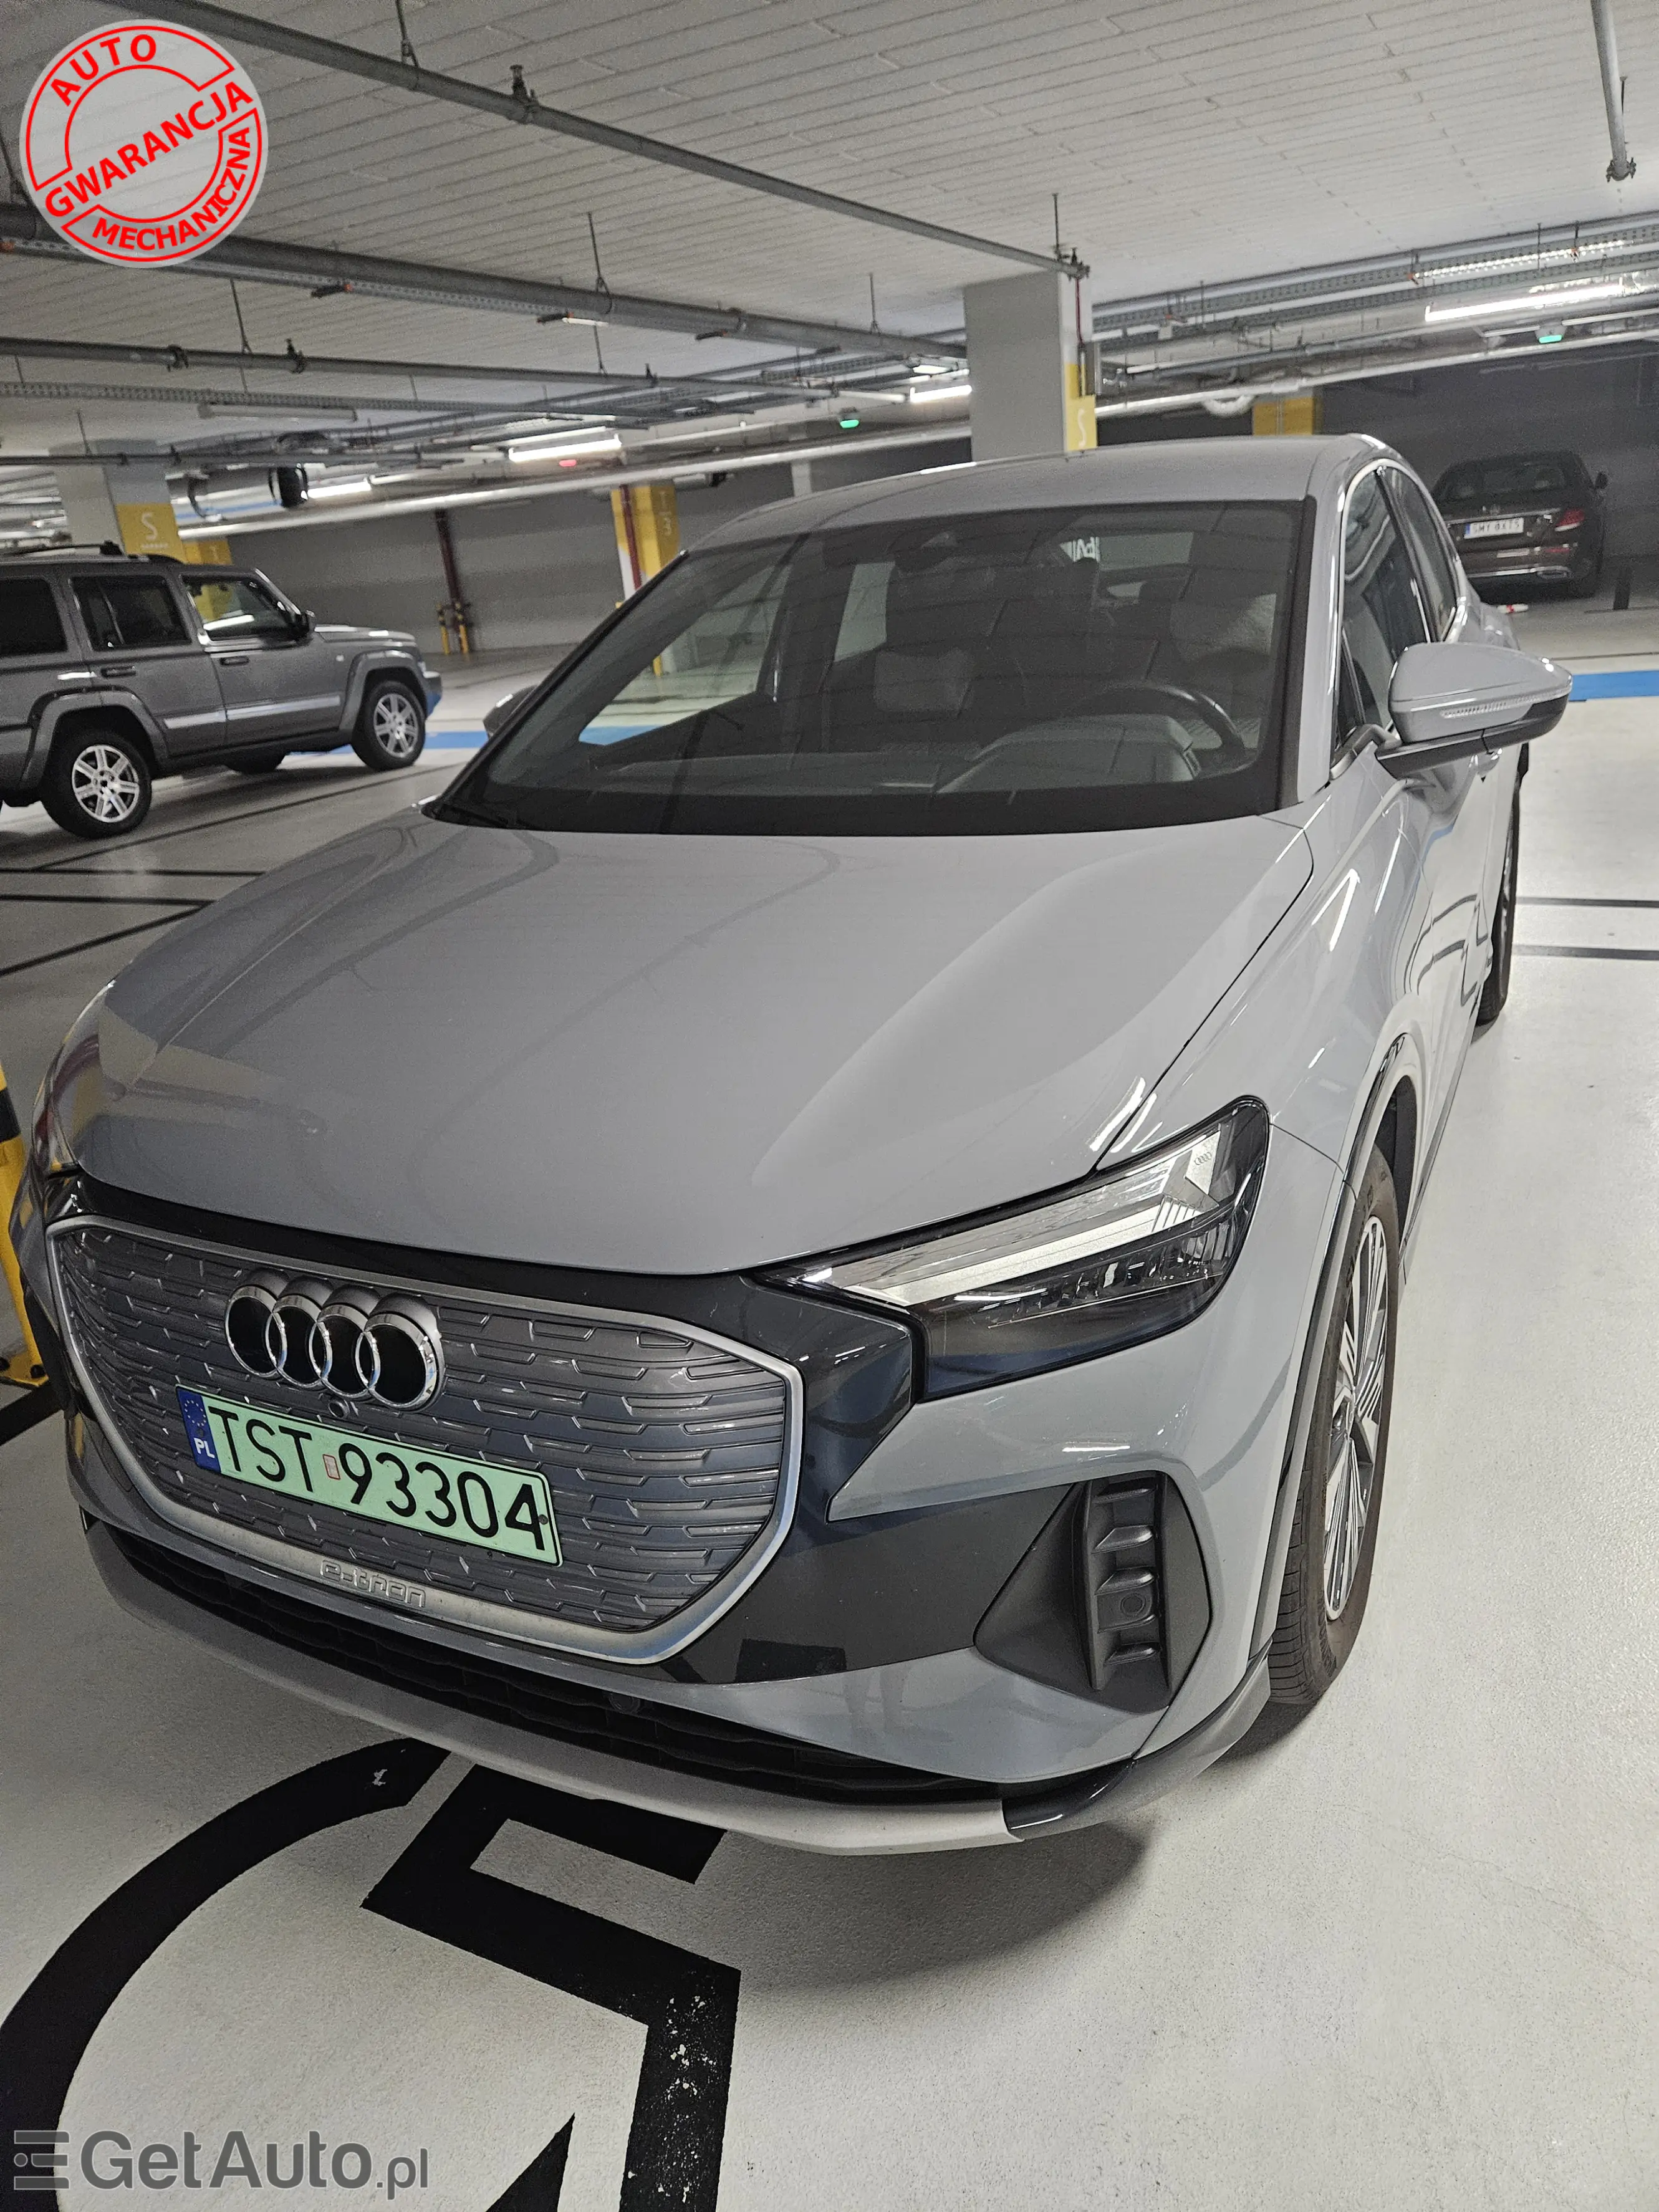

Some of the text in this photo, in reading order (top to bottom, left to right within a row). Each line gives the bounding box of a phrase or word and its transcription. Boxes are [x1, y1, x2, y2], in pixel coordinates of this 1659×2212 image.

[141, 512, 158, 541] S
[193, 1437, 216, 1459] PL
[208, 1405, 546, 1551] TST 93304
[320, 1559, 426, 1608] e-tron
